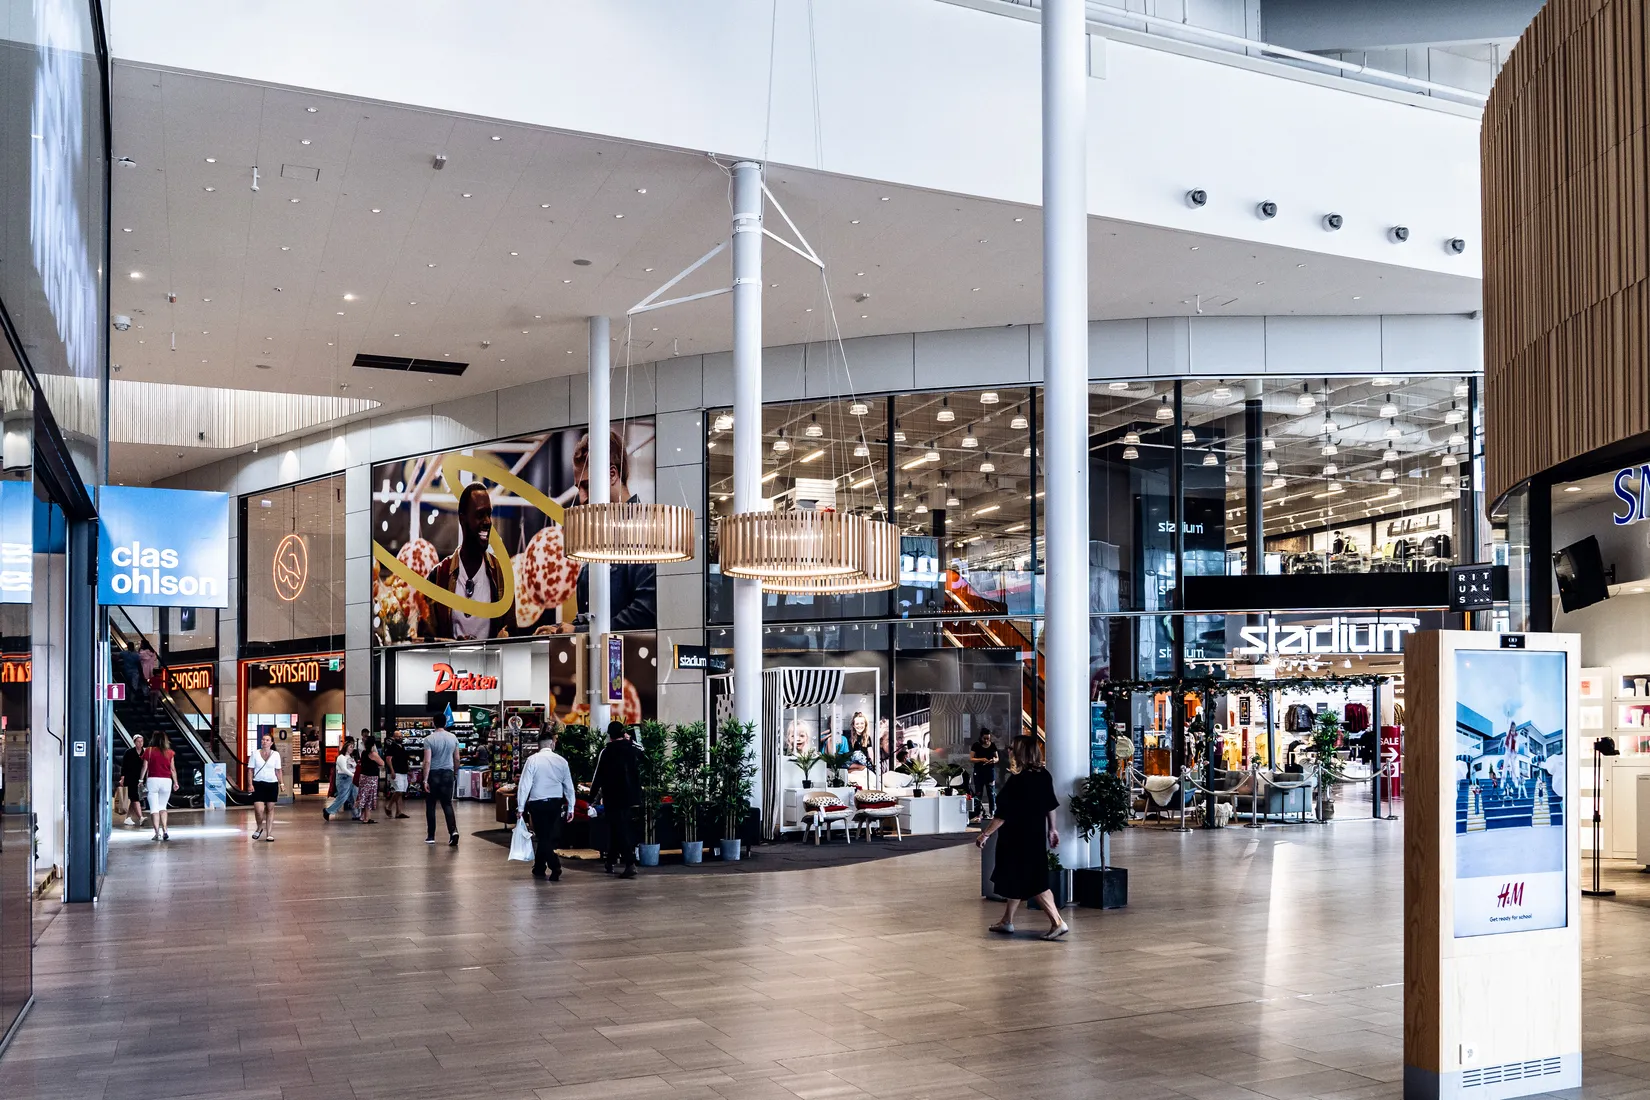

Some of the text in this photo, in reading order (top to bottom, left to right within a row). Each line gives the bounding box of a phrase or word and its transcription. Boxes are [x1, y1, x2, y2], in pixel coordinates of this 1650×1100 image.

[1158, 520, 1203, 534] staium
[111, 541, 179, 569] clas
[111, 567, 217, 596] ohlson
[1239, 616, 1417, 655] stadium
[269, 661, 319, 684] SYNSAM
[679, 654, 707, 667] stadium
[171, 669, 209, 690] SYNSAM
[432, 662, 498, 693] Direkten
[1497, 881, 1524, 908] H&M
